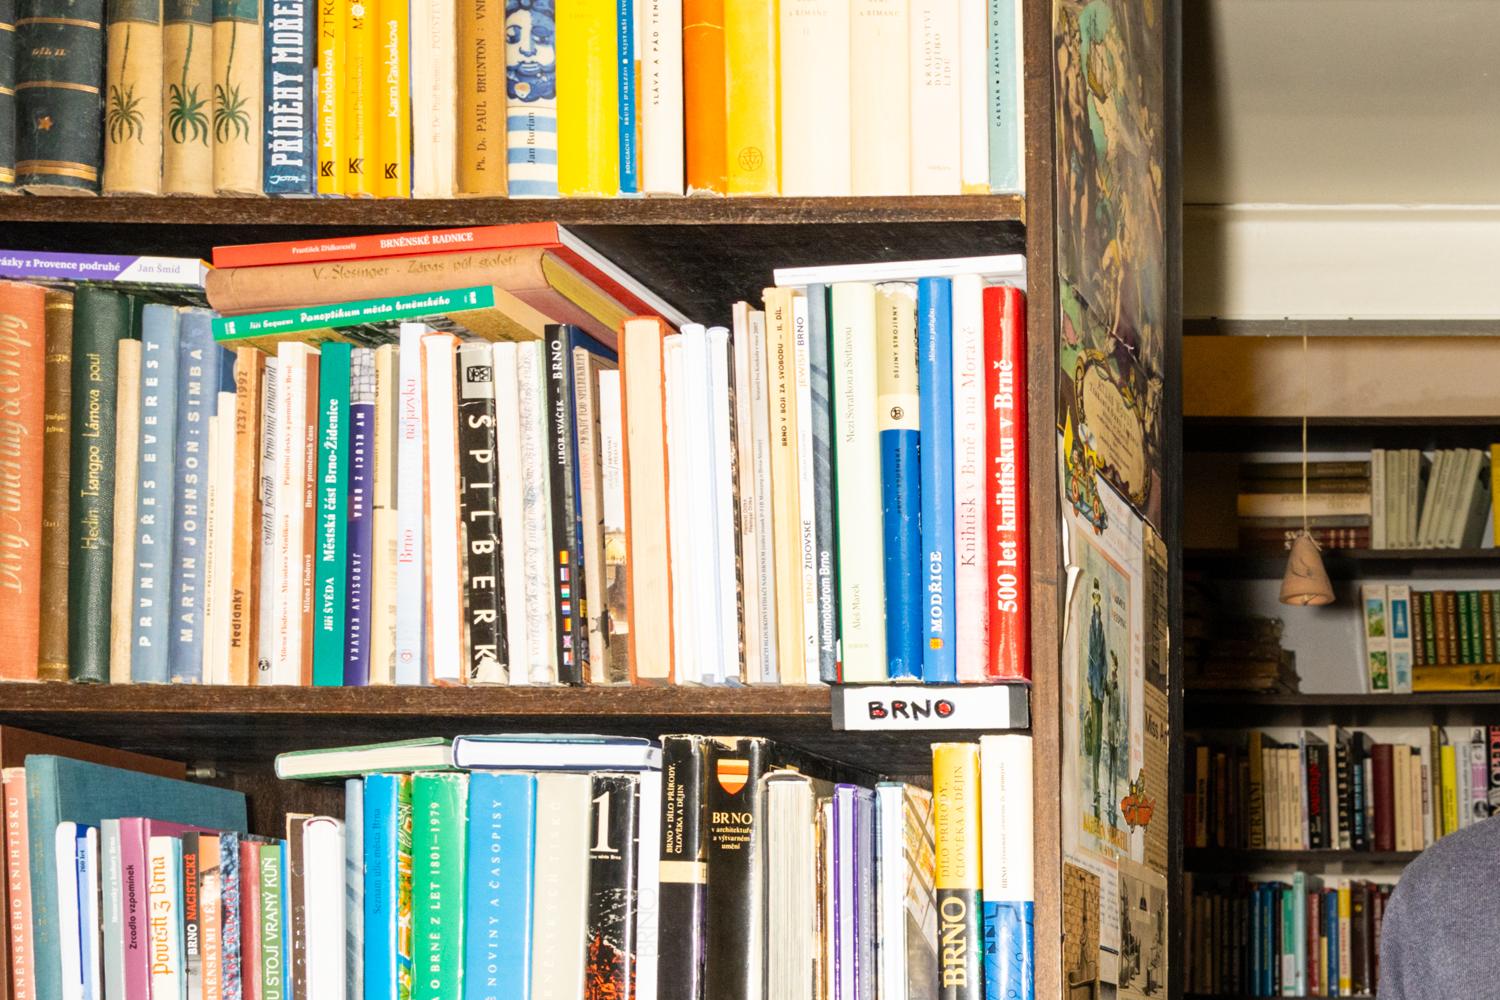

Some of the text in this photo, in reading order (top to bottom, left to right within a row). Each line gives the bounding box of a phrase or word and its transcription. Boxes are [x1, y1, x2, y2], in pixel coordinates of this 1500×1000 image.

[268, 0, 303, 167] PŘÍBĚHY MOŘE
[526, 146, 536, 165] Jan
[138, 262, 156, 274] Jan
[380, 232, 473, 248] BRNĚNSKÉ RADNICE
[300, 308, 360, 325] Panoptikum
[363, 303, 393, 317] města
[139, 342, 158, 647] PRVNÍ PŘES EVEREST
[323, 398, 338, 562] Městská část Brno-Židenice
[993, 359, 1018, 613] 500 let knihtisku v Brně
[468, 415, 497, 668] ŠPILBERK
[818, 551, 832, 651] Automotodrom Brno
[930, 551, 943, 633] MODŘICE
[869, 700, 955, 720] BRNO
[590, 791, 618, 853] 1
[712, 812, 752, 824] BRNO
[127, 864, 139, 950] Zrcadlo vzpomínek
[184, 853, 197, 955] BRNO NACISTICKÉ
[262, 856, 276, 886] KŮŇ
[264, 890, 278, 942] VRANÝ
[940, 896, 967, 989] BRNO
[265, 945, 278, 989] STOJÍ
